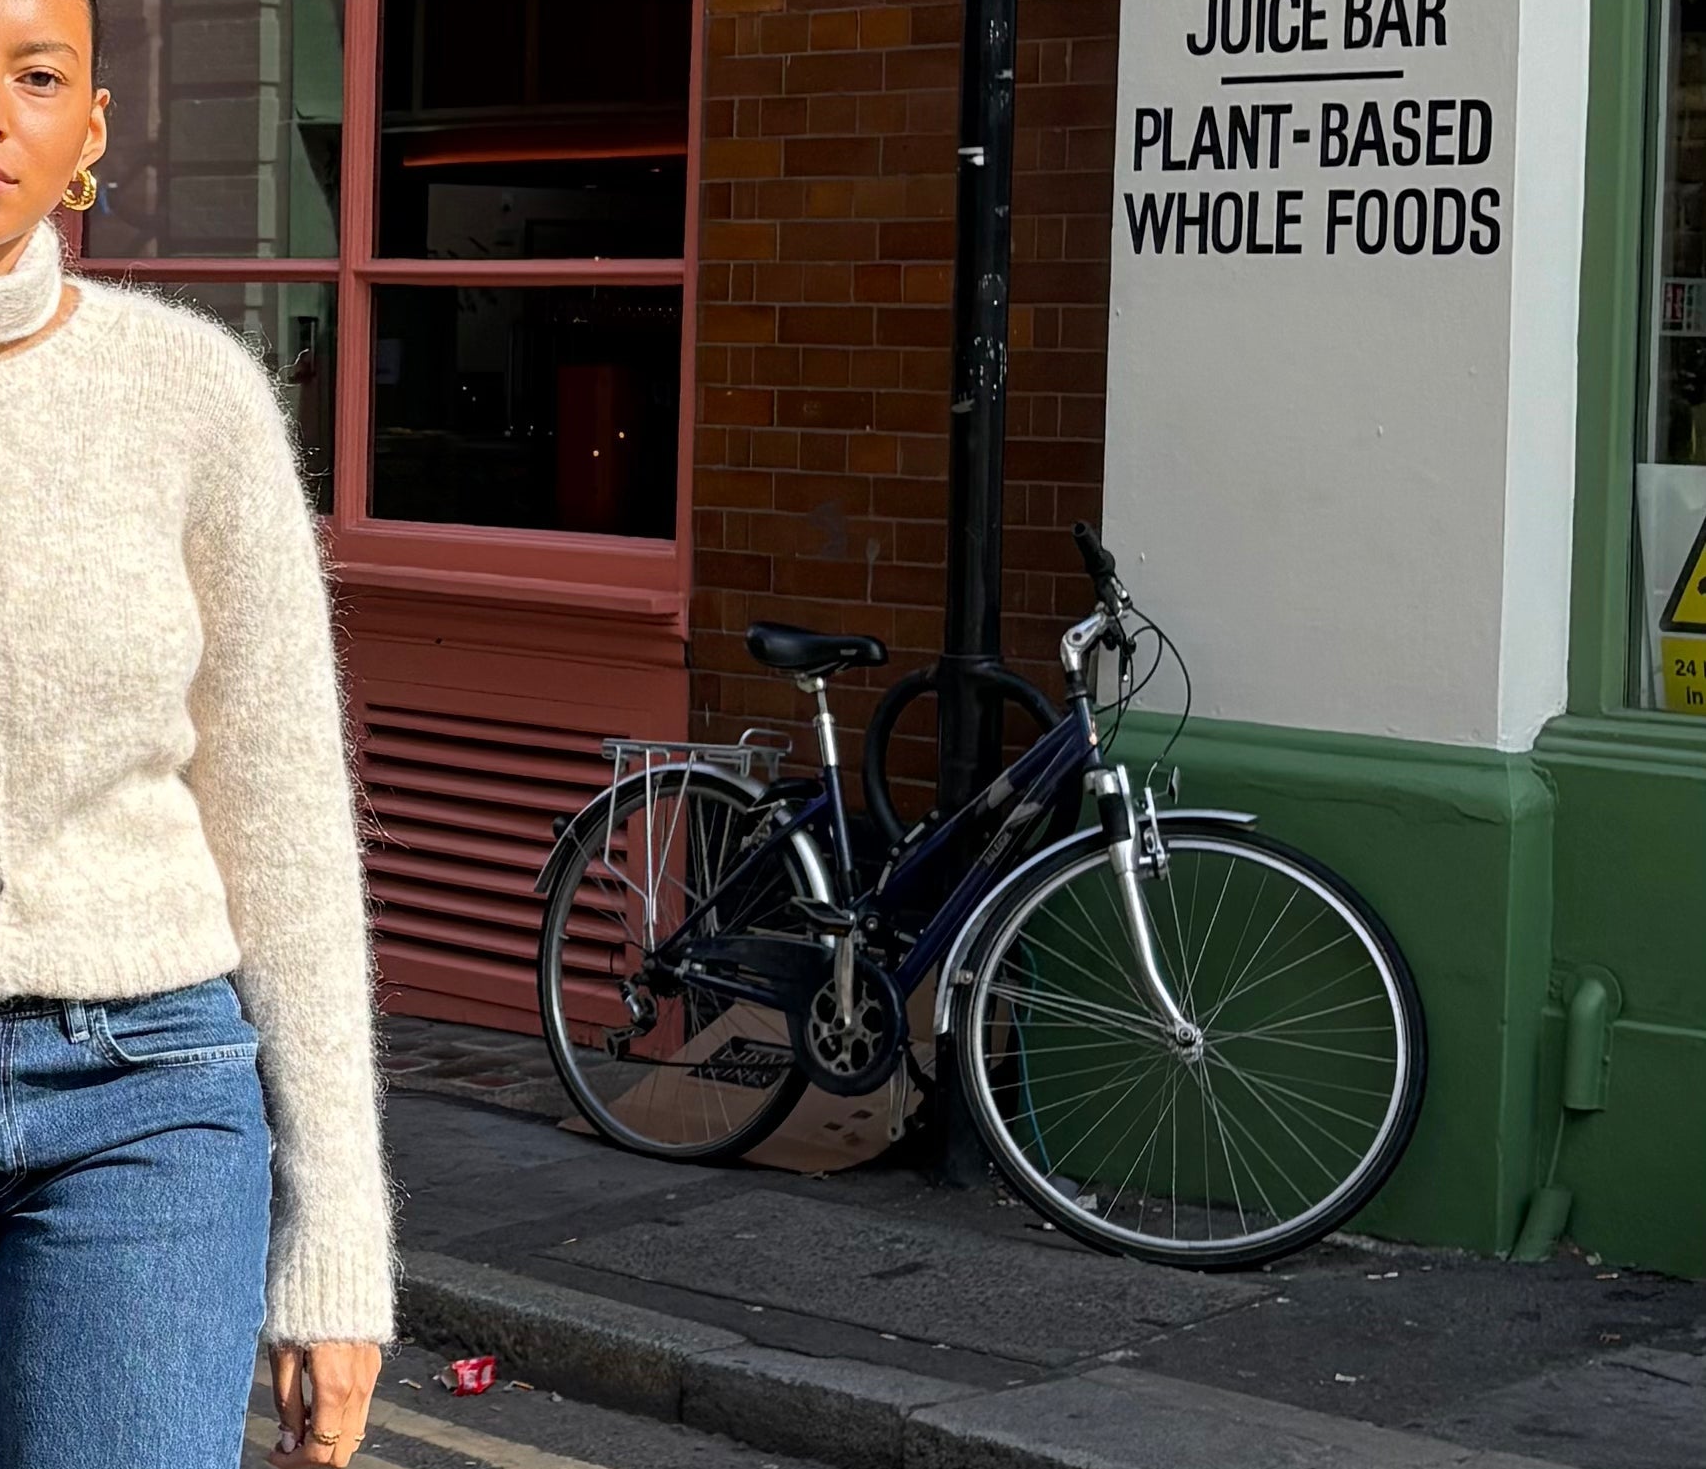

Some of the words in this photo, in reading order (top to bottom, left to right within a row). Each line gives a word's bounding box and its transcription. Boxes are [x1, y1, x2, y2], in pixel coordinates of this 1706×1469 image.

[1132, 99, 1494, 172] PLANT-BASED
[1124, 190, 1304, 256] WHOLE
[1325, 187, 1501, 256] FOODS
[1675, 658, 1697, 677] 24
